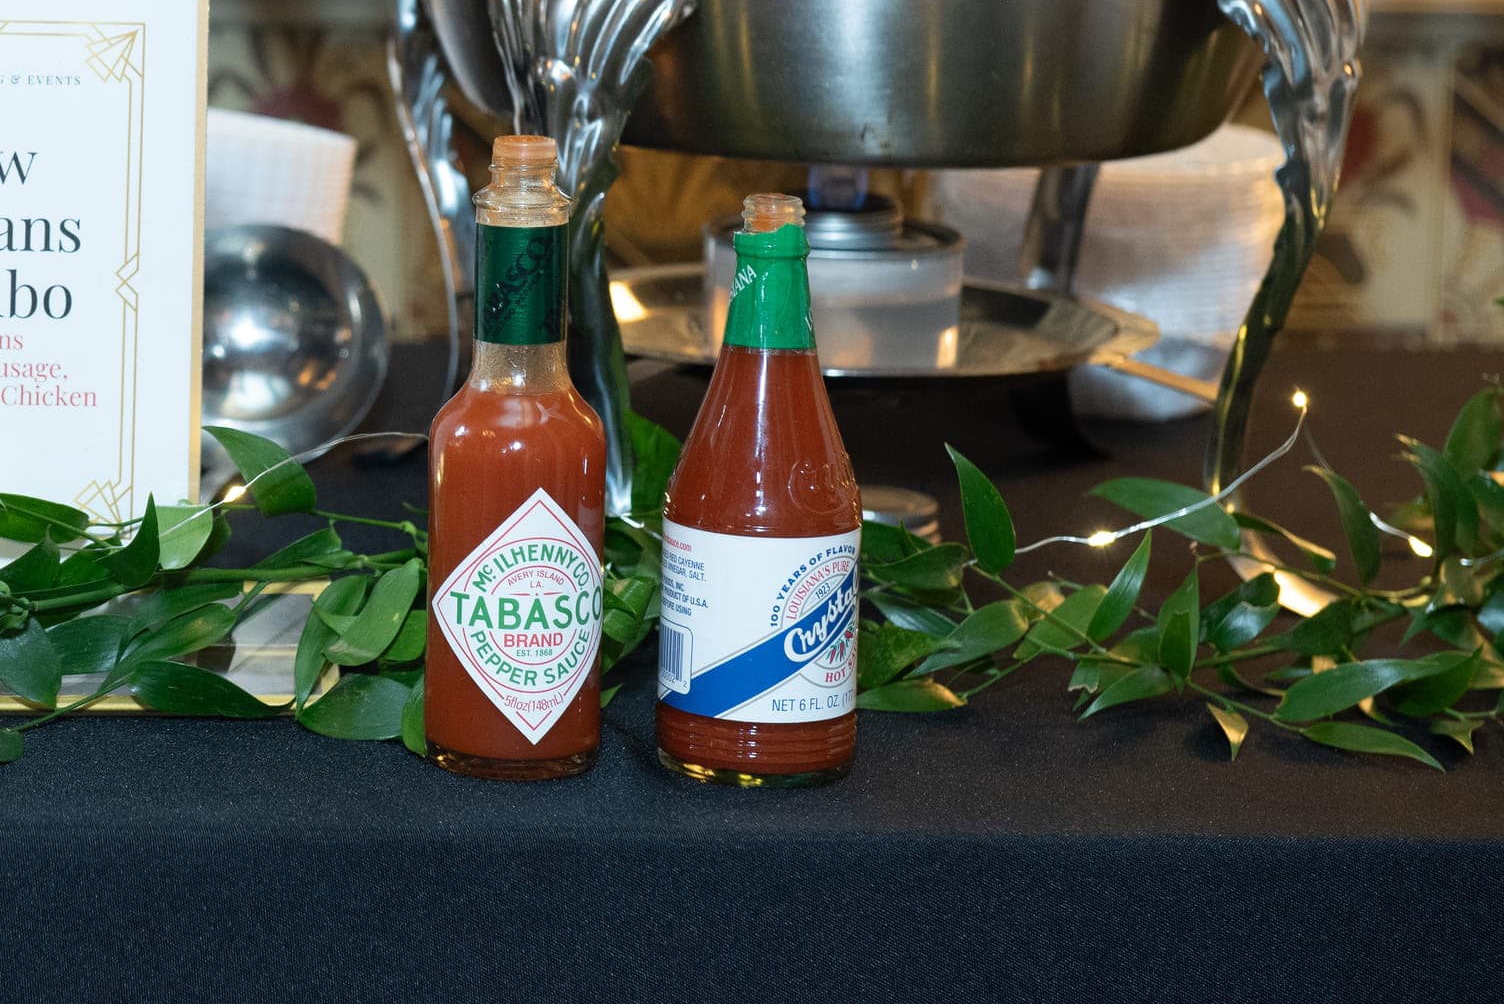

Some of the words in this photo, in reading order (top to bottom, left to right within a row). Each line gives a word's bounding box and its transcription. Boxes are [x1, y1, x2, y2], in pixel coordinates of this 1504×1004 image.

[10, 74, 22, 85] &
[27, 75, 81, 86] EVENTS
[1, 384, 97, 407] Chicken
[677, 556, 705, 571] CAYENNE
[507, 570, 534, 586] AVERY
[536, 570, 565, 586] ISLAND
[530, 580, 545, 589] LA.
[770, 605, 781, 627] 100
[776, 564, 807, 600] YEARS
[809, 552, 823, 566] OF
[786, 565, 831, 620] LOUISIANA'S
[832, 560, 850, 573] PURE
[815, 582, 831, 599] 1923
[450, 585, 602, 631] TABASCO
[690, 597, 709, 608] U.S.A.
[503, 632, 563, 648] BRAND
[470, 630, 538, 686] PEPPER
[543, 629, 590, 684] SAUCE
[516, 649, 531, 657] EST.
[535, 648, 553, 657] 1868
[825, 667, 846, 683] HOT
[772, 698, 795, 712] NET
[799, 698, 806, 711] 6
[809, 698, 824, 710] FL.
[827, 694, 840, 708] OZ.
